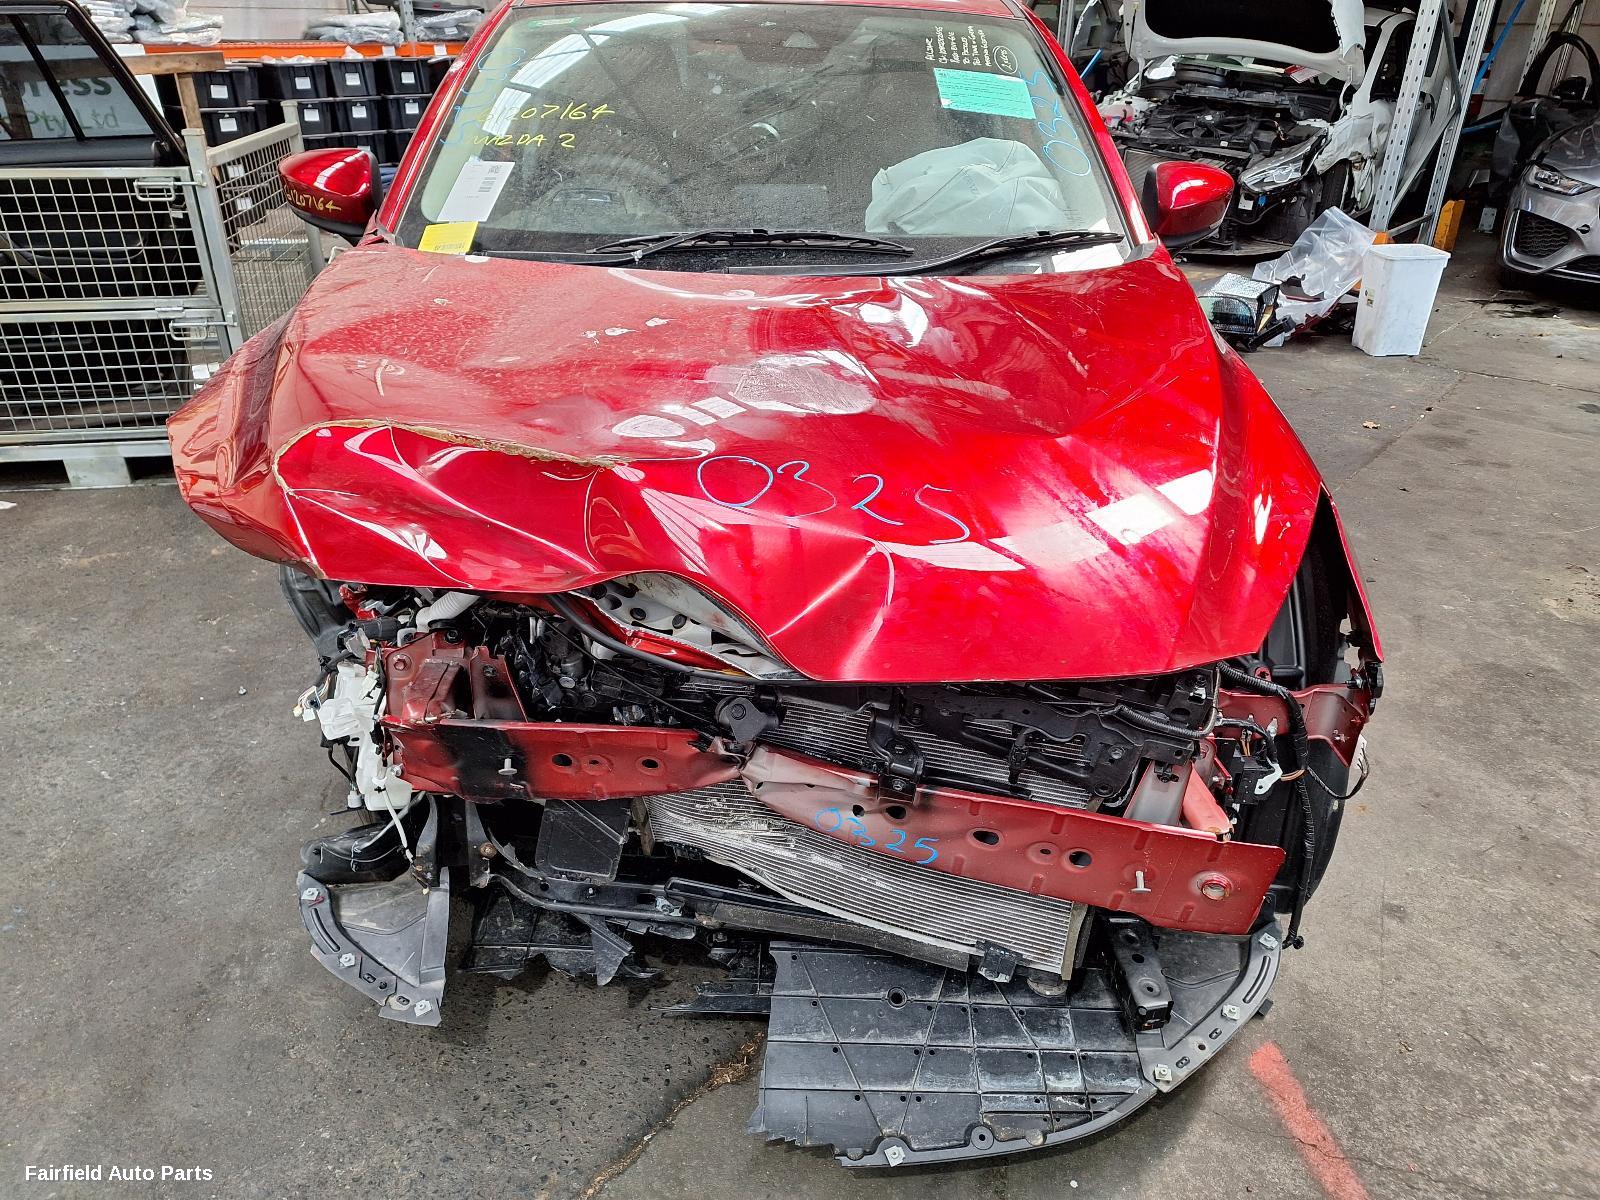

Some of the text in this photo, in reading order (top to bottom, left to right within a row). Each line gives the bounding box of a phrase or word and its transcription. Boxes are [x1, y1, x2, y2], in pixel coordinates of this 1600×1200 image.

[76, 105, 119, 130] Ltd
[559, 133, 576, 148] 2
[697, 455, 970, 544] 0325
[815, 807, 940, 865] 0325
